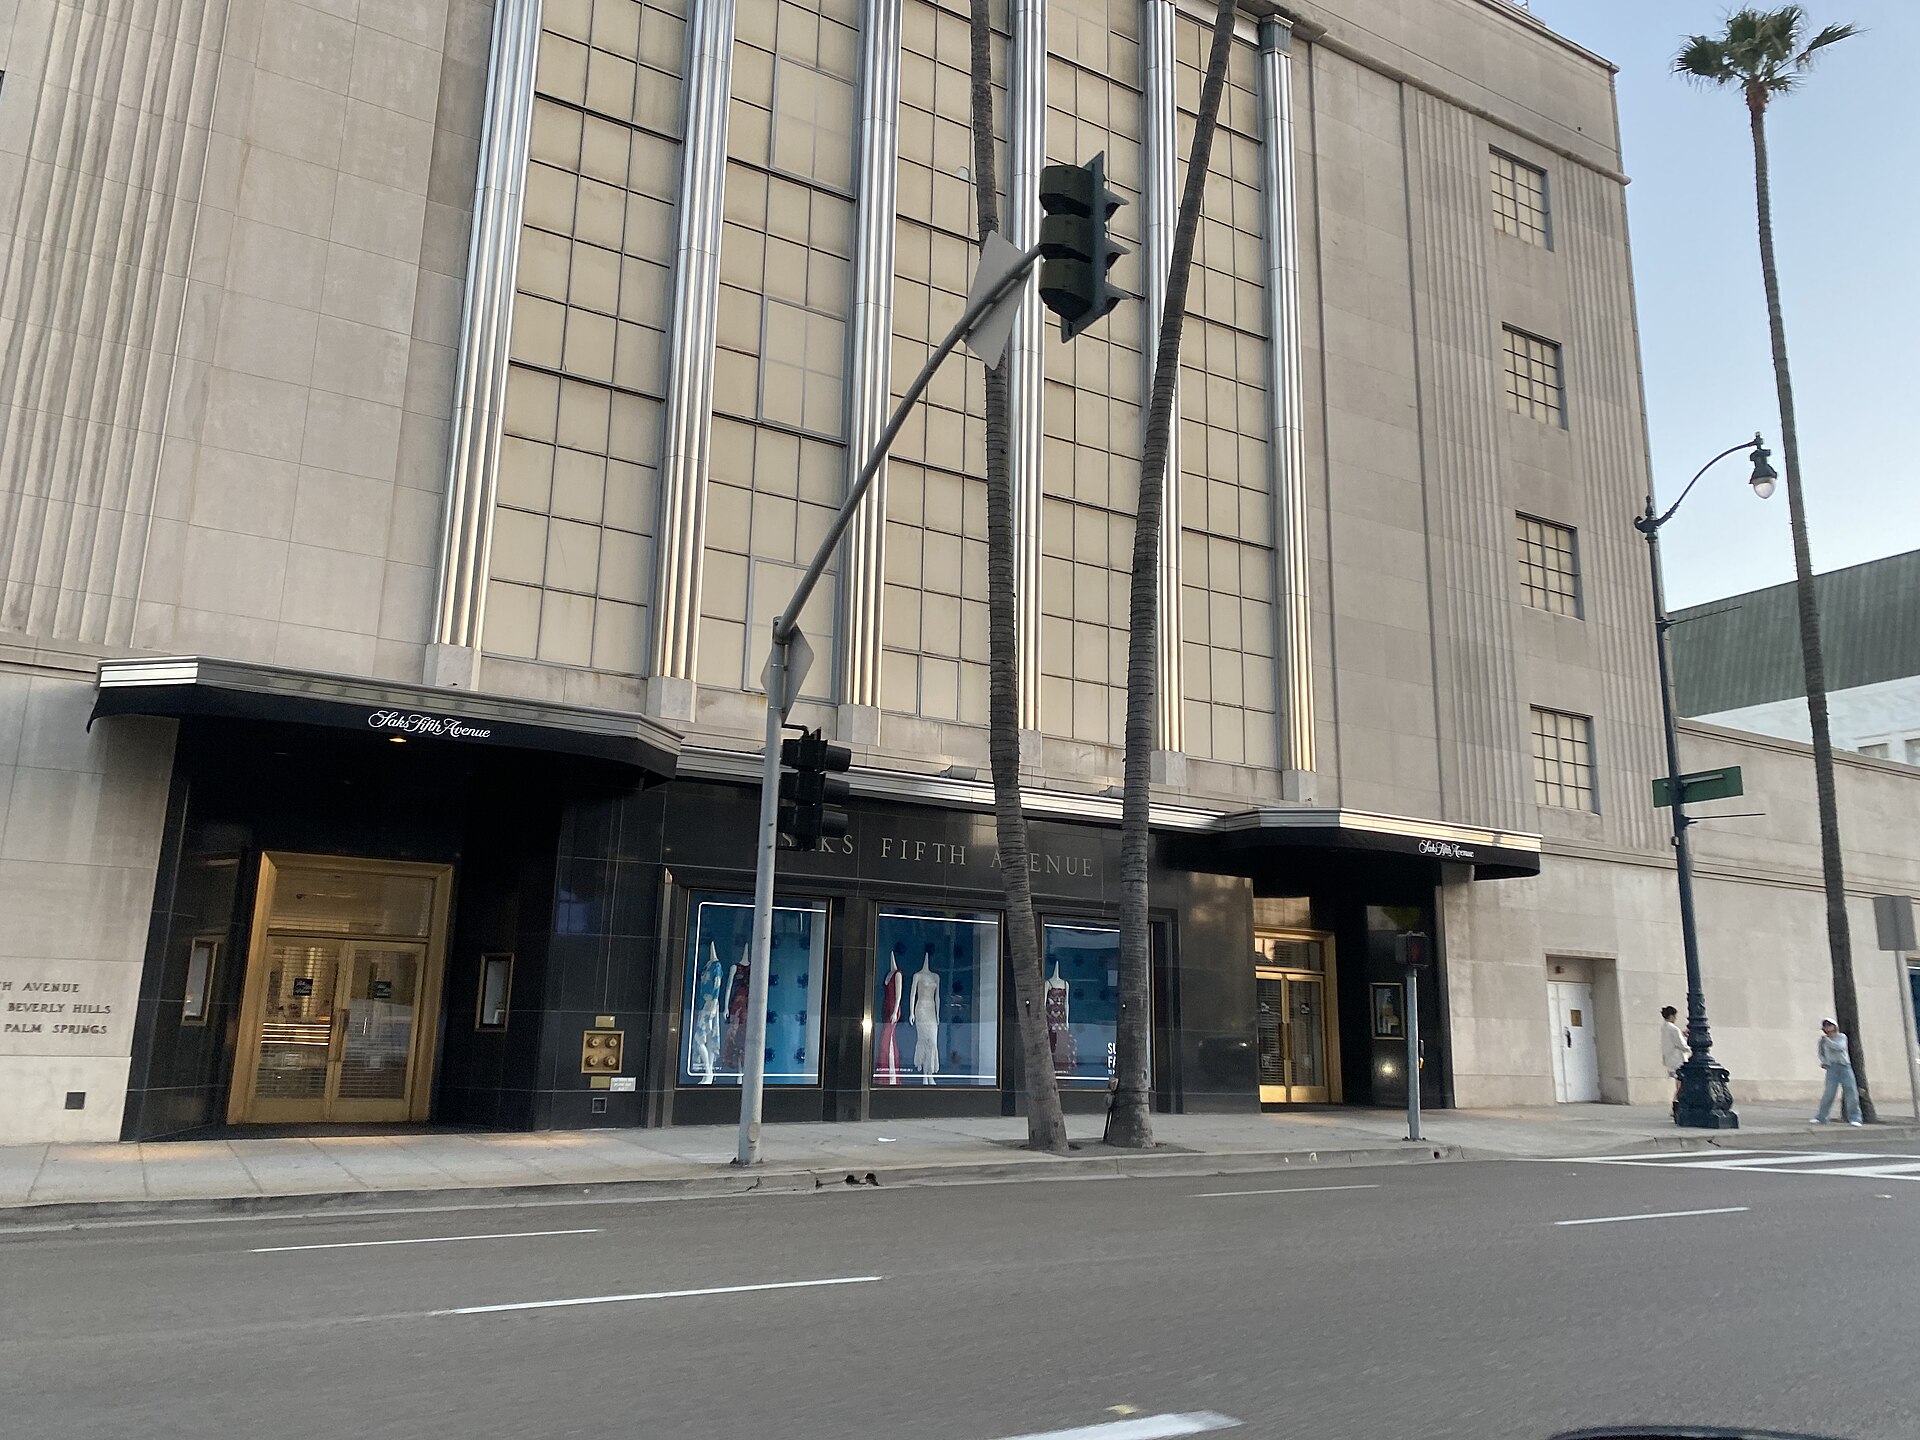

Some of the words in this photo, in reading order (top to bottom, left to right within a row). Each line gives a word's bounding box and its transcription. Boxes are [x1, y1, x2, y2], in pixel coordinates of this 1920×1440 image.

[368, 710, 409, 728] Saks
[404, 714, 442, 735] Fifth
[433, 718, 491, 738] Avenue
[781, 832, 853, 855] SKS
[880, 837, 967, 866] FIFTH
[989, 849, 1094, 878] AENUE
[22, 982, 80, 993] AVENUE
[7, 1002, 66, 1013] BEVERLY
[72, 1004, 111, 1014] HILLS
[4, 1023, 42, 1033] PALM
[52, 1024, 108, 1034] SPRINGS
